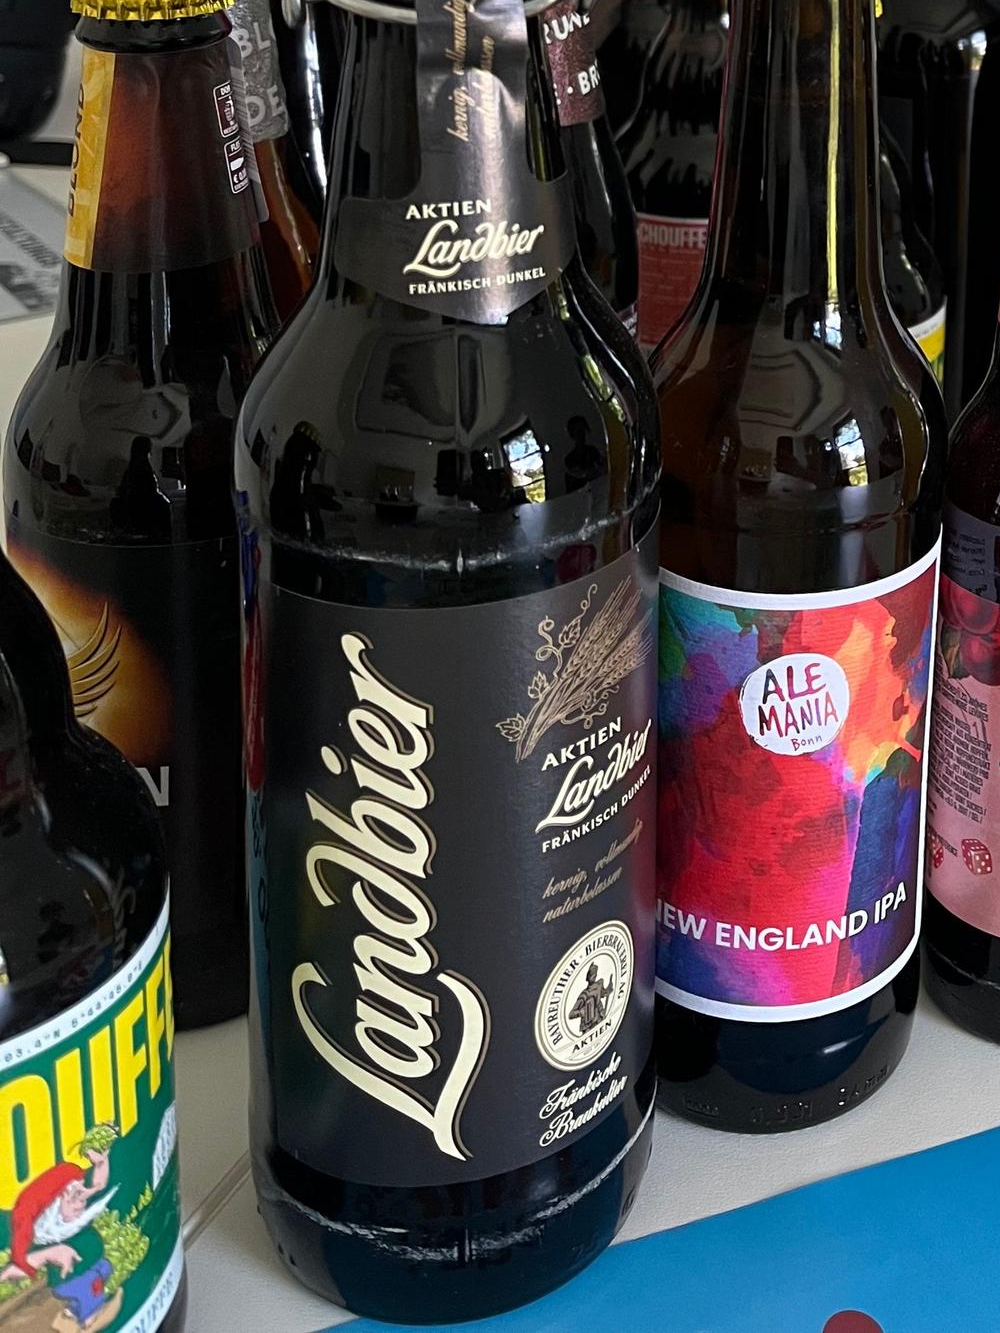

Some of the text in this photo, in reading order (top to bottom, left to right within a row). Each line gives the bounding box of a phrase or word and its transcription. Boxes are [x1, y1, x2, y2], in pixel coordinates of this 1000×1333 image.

[406, 199, 491, 220] AKTIEN
[403, 219, 544, 278] Landbier
[409, 267, 546, 295] FRÄNKISCH DUNKEL
[761, 661, 828, 704] ALE
[758, 690, 840, 738] MANIA
[541, 717, 622, 772] AKTIEN
[791, 734, 823, 752] Bonn
[535, 718, 652, 834] Landbier
[542, 765, 651, 853] FRÄNKISCH DUNKEL
[291, 631, 491, 1162] Landbier
[715, 909, 868, 952] ENGLAND
[873, 882, 907, 926] IPA
[547, 958, 580, 1046] BAYREUTHER
[571, 1019, 612, 1054] AKTIEN
